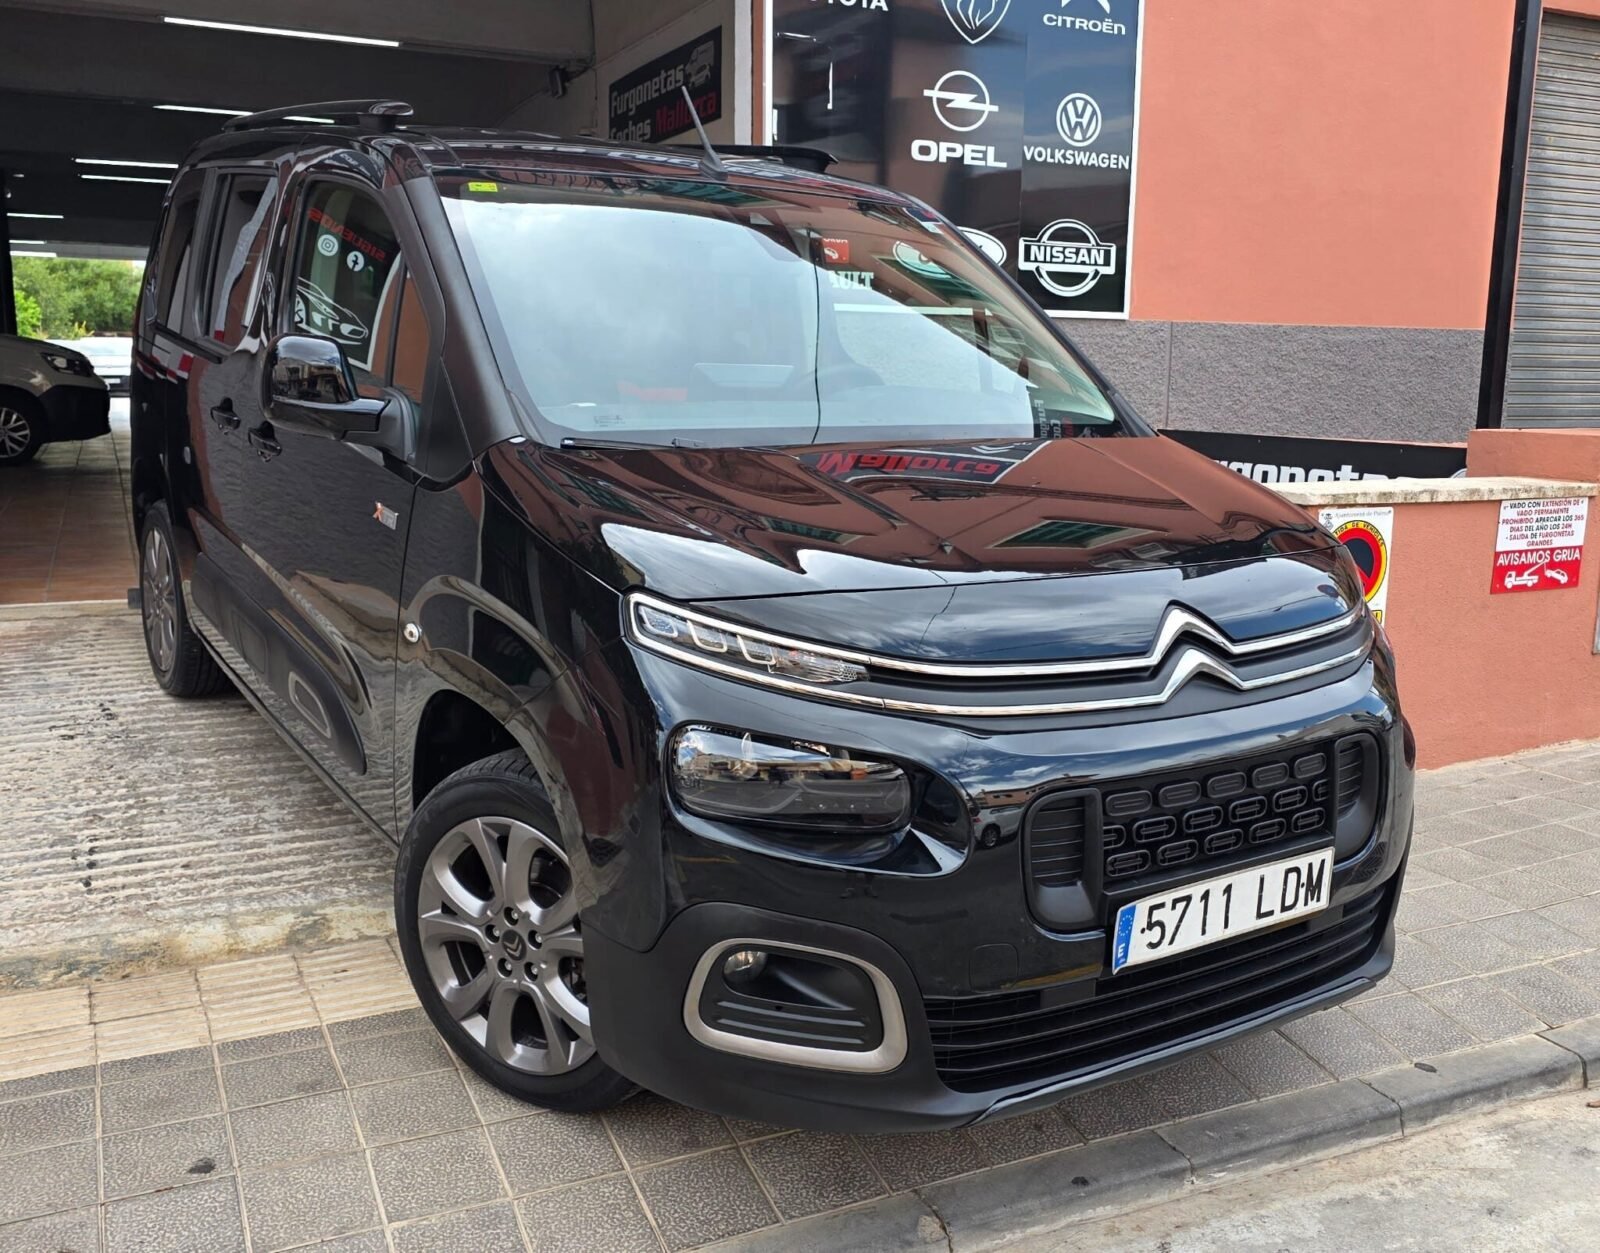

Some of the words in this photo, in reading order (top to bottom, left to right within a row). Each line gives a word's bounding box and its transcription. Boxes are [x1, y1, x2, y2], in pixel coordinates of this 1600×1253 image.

[611, 64, 684, 118] Furgonetas
[910, 139, 1008, 168] OPEL
[1023, 145, 1130, 170] VOLKSWAGEN
[1030, 245, 1105, 265] NISSAN
[1502, 517, 1534, 525] PROHIBIDO
[1509, 533, 1529, 541] SALIDA
[1539, 530, 1574, 538] FURGONETAS
[1497, 550, 1550, 566] AVISAMOS
[1553, 548, 1580, 562] GRUA
[1145, 883, 1233, 949] 5711
[1256, 859, 1326, 920] LDM
